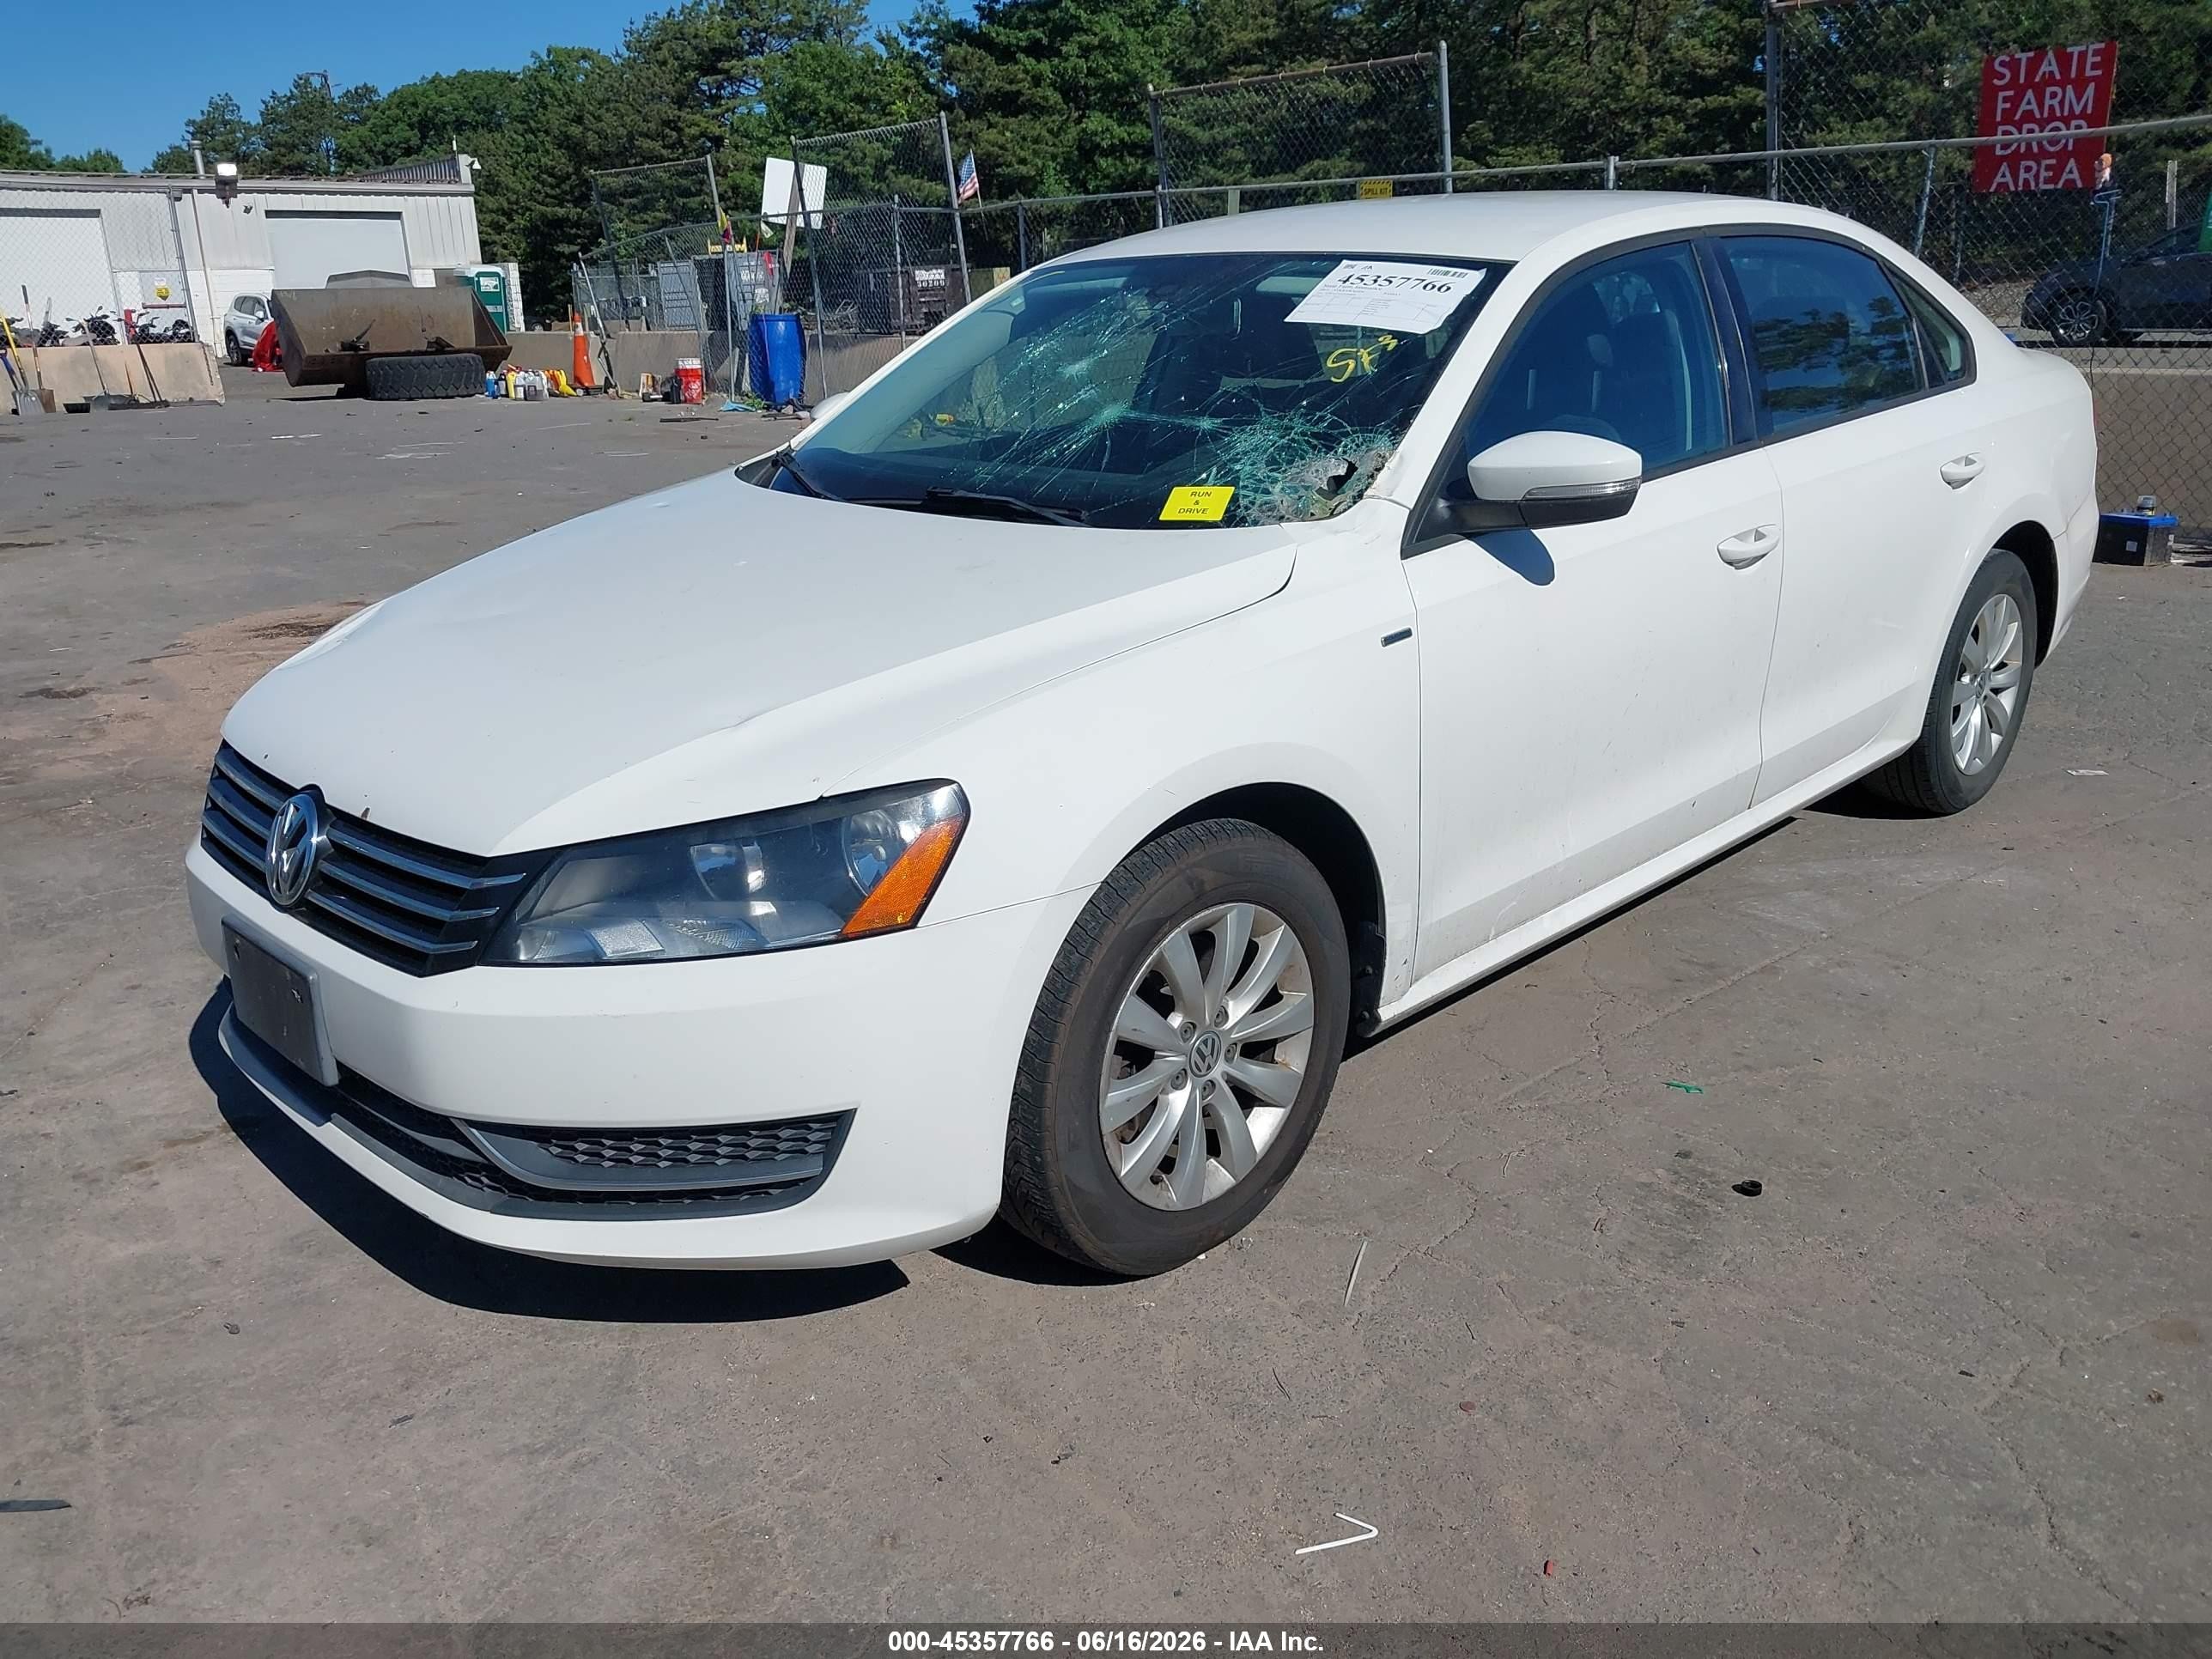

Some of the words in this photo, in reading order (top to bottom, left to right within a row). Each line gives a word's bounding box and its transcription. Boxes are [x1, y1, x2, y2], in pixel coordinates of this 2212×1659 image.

[1992, 44, 2106, 86] STATE
[1995, 82, 2096, 122] FARM
[1995, 119, 2088, 155] DROP
[1989, 158, 2083, 191] AREA
[1337, 273, 1457, 294] 45357766
